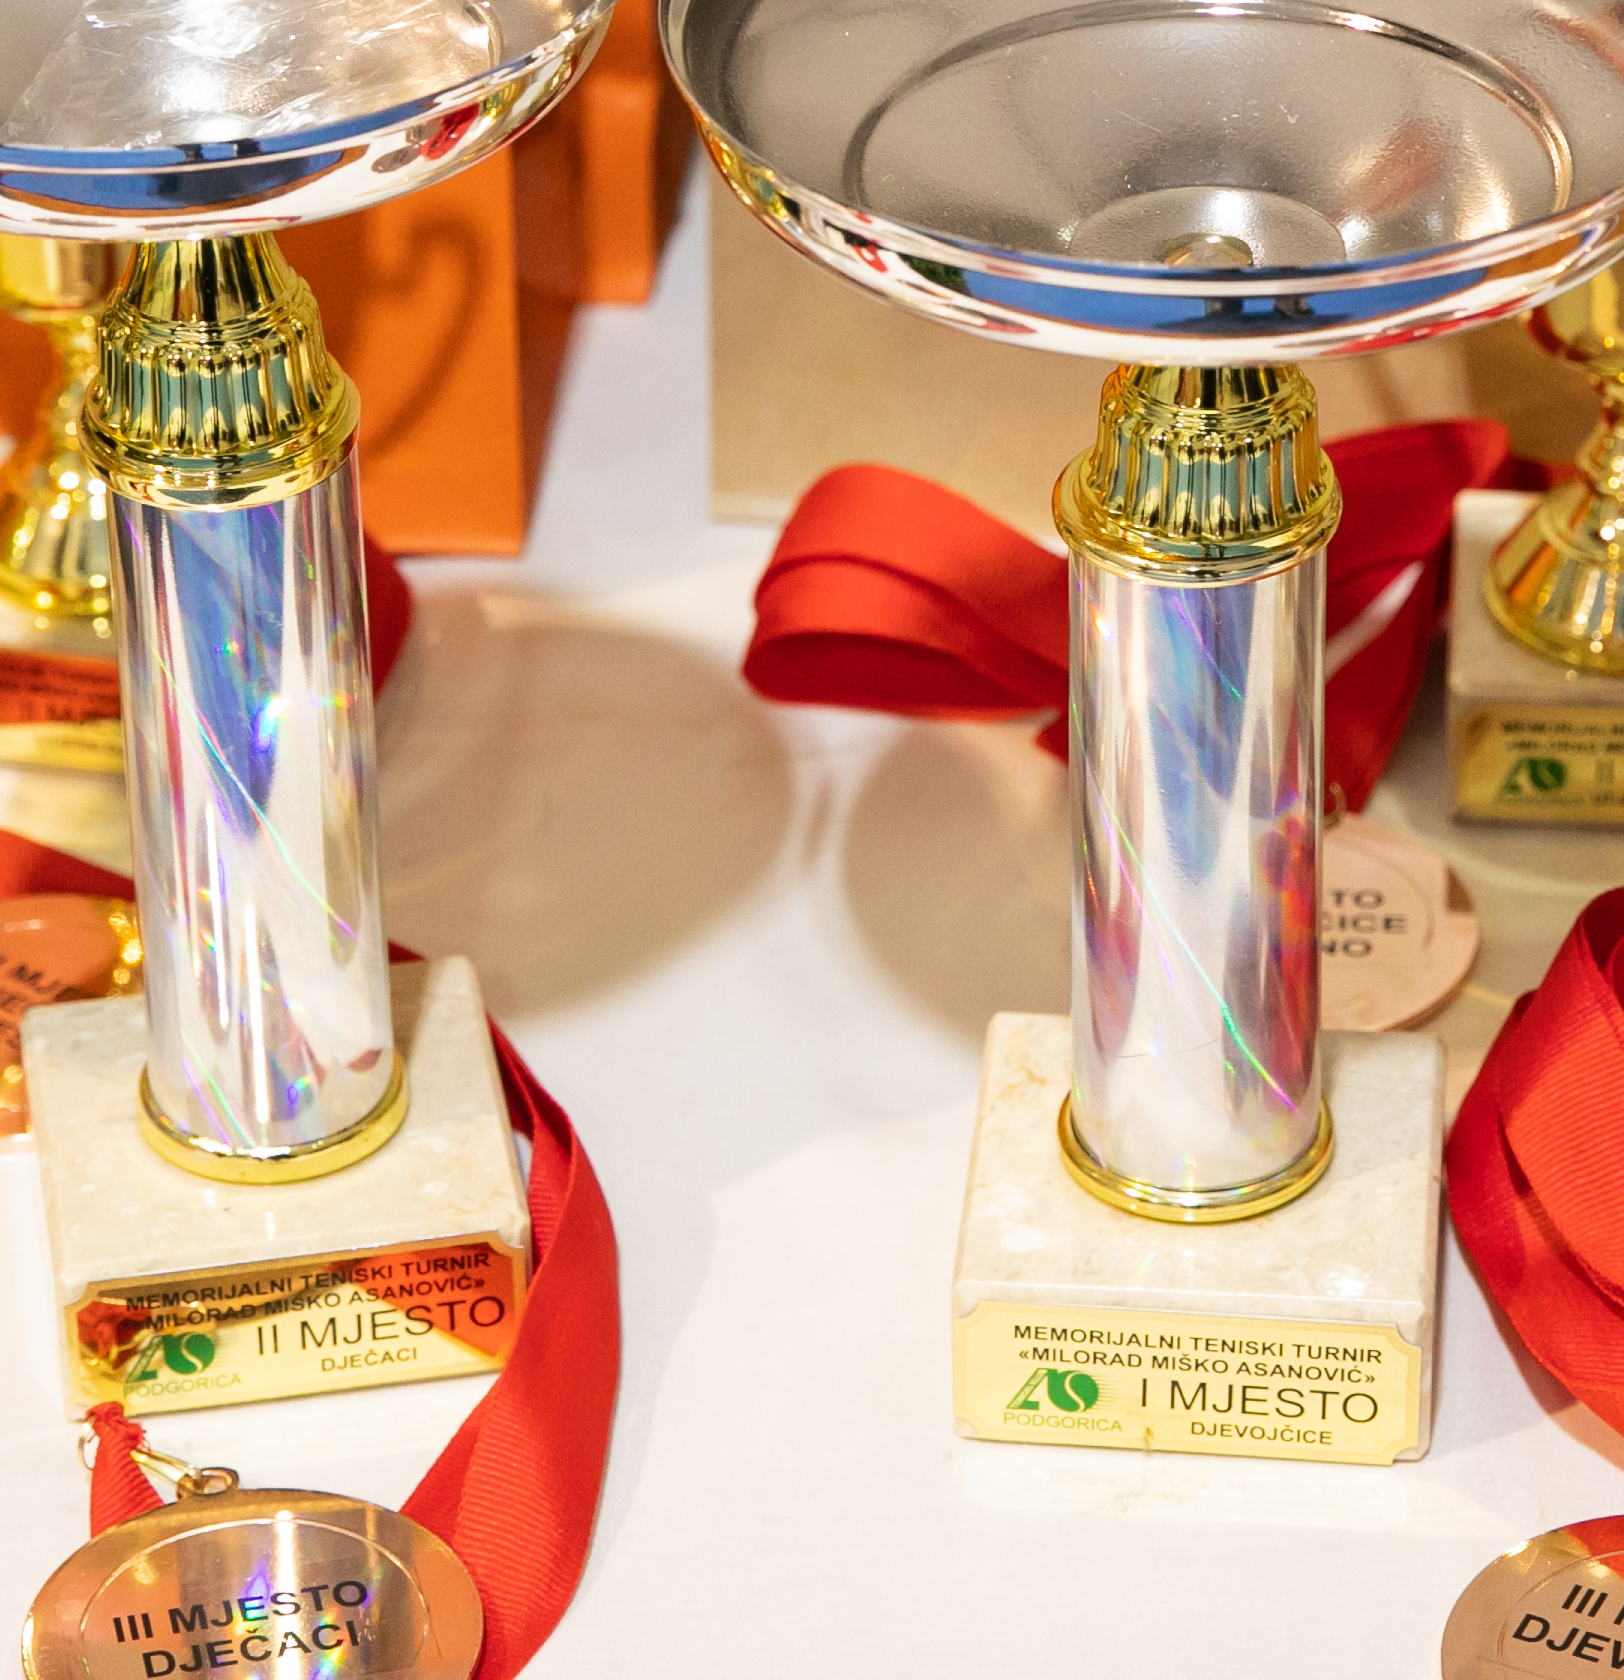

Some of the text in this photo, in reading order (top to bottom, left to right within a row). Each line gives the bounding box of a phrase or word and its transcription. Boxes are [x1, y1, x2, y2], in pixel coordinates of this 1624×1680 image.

[126, 1252, 491, 1313] MEMORIJALNI TENISKI TURNIR
[263, 1290, 341, 1319] MIŠKO
[349, 1273, 485, 1306] ASANOVIĆ»
[257, 1294, 506, 1357] II MJESTO
[1013, 1324, 1383, 1365] MEMORIJALNI TENISKI TURNIR
[321, 1347, 418, 1373] DJEČACI
[1018, 1346, 1376, 1385] «MILORAD MIŠKO ASANOVIĆ»
[124, 1372, 242, 1400] PODGORICA
[1139, 1377, 1380, 1425] I MJESTO
[1003, 1412, 1123, 1433] PODGORICA
[1190, 1421, 1333, 1446] DJEVOJČICE
[112, 1580, 368, 1643] III MJESTO
[1561, 1584, 1609, 1618] III
[142, 1620, 360, 1678] DJEČACI
